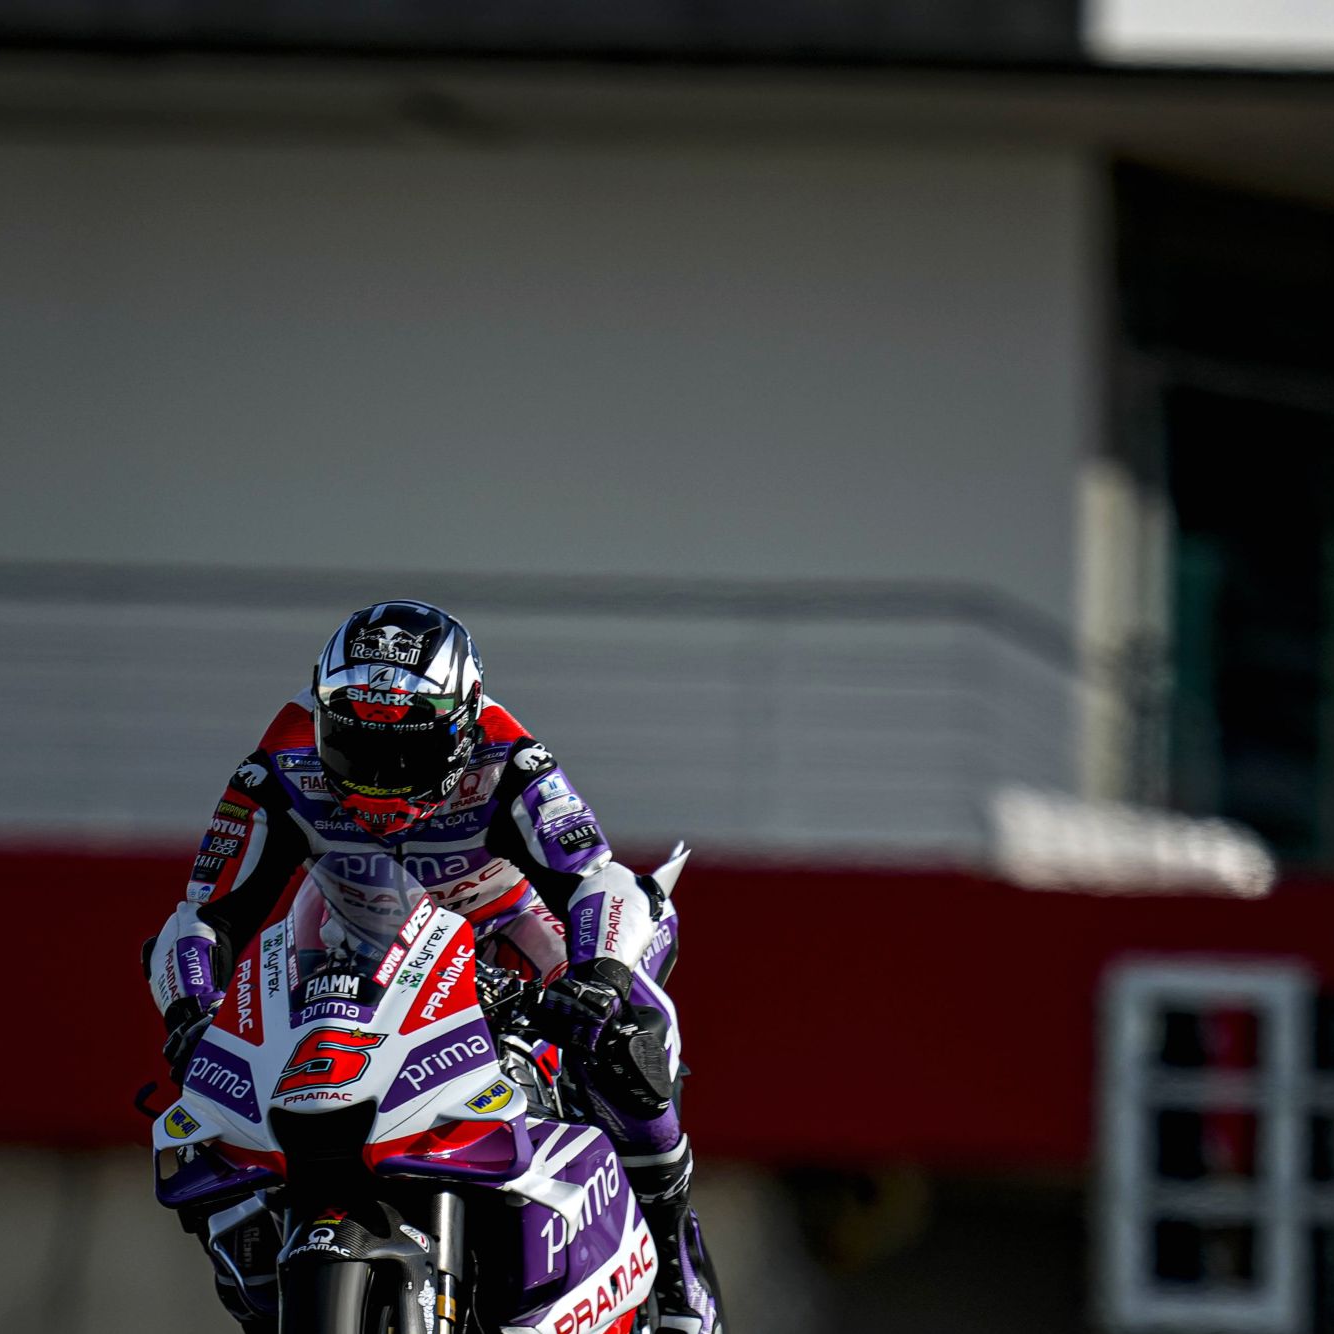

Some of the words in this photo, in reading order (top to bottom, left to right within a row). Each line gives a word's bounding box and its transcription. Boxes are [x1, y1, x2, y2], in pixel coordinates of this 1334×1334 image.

[350, 643, 383, 660] Red
[384, 648, 420, 665] Bull
[346, 687, 415, 706] SHARK
[327, 711, 355, 726] GIVES
[361, 721, 385, 731] YOU
[393, 721, 434, 731] WINGS
[300, 775, 328, 789] FIA
[314, 820, 365, 833] SHARK
[559, 824, 597, 845] CRAFT
[335, 853, 470, 882] prima
[579, 908, 596, 946] prima
[604, 896, 625, 952] PRAMAC
[181, 946, 205, 985] prima
[375, 946, 406, 985] MOTUL
[305, 974, 360, 999] FIAMM
[420, 944, 475, 1021] PRAMAC
[237, 959, 254, 1034] PRAMAC
[300, 1002, 360, 1025] prima
[271, 1026, 389, 1100] 5
[399, 1035, 490, 1091] prima
[187, 1057, 252, 1100] prima
[283, 1091, 353, 1106] PRAMAC
[471, 1084, 508, 1110] WD-40
[169, 1109, 196, 1135] WD-40
[540, 1151, 620, 1274] pima
[288, 1243, 352, 1259] PRAMAC
